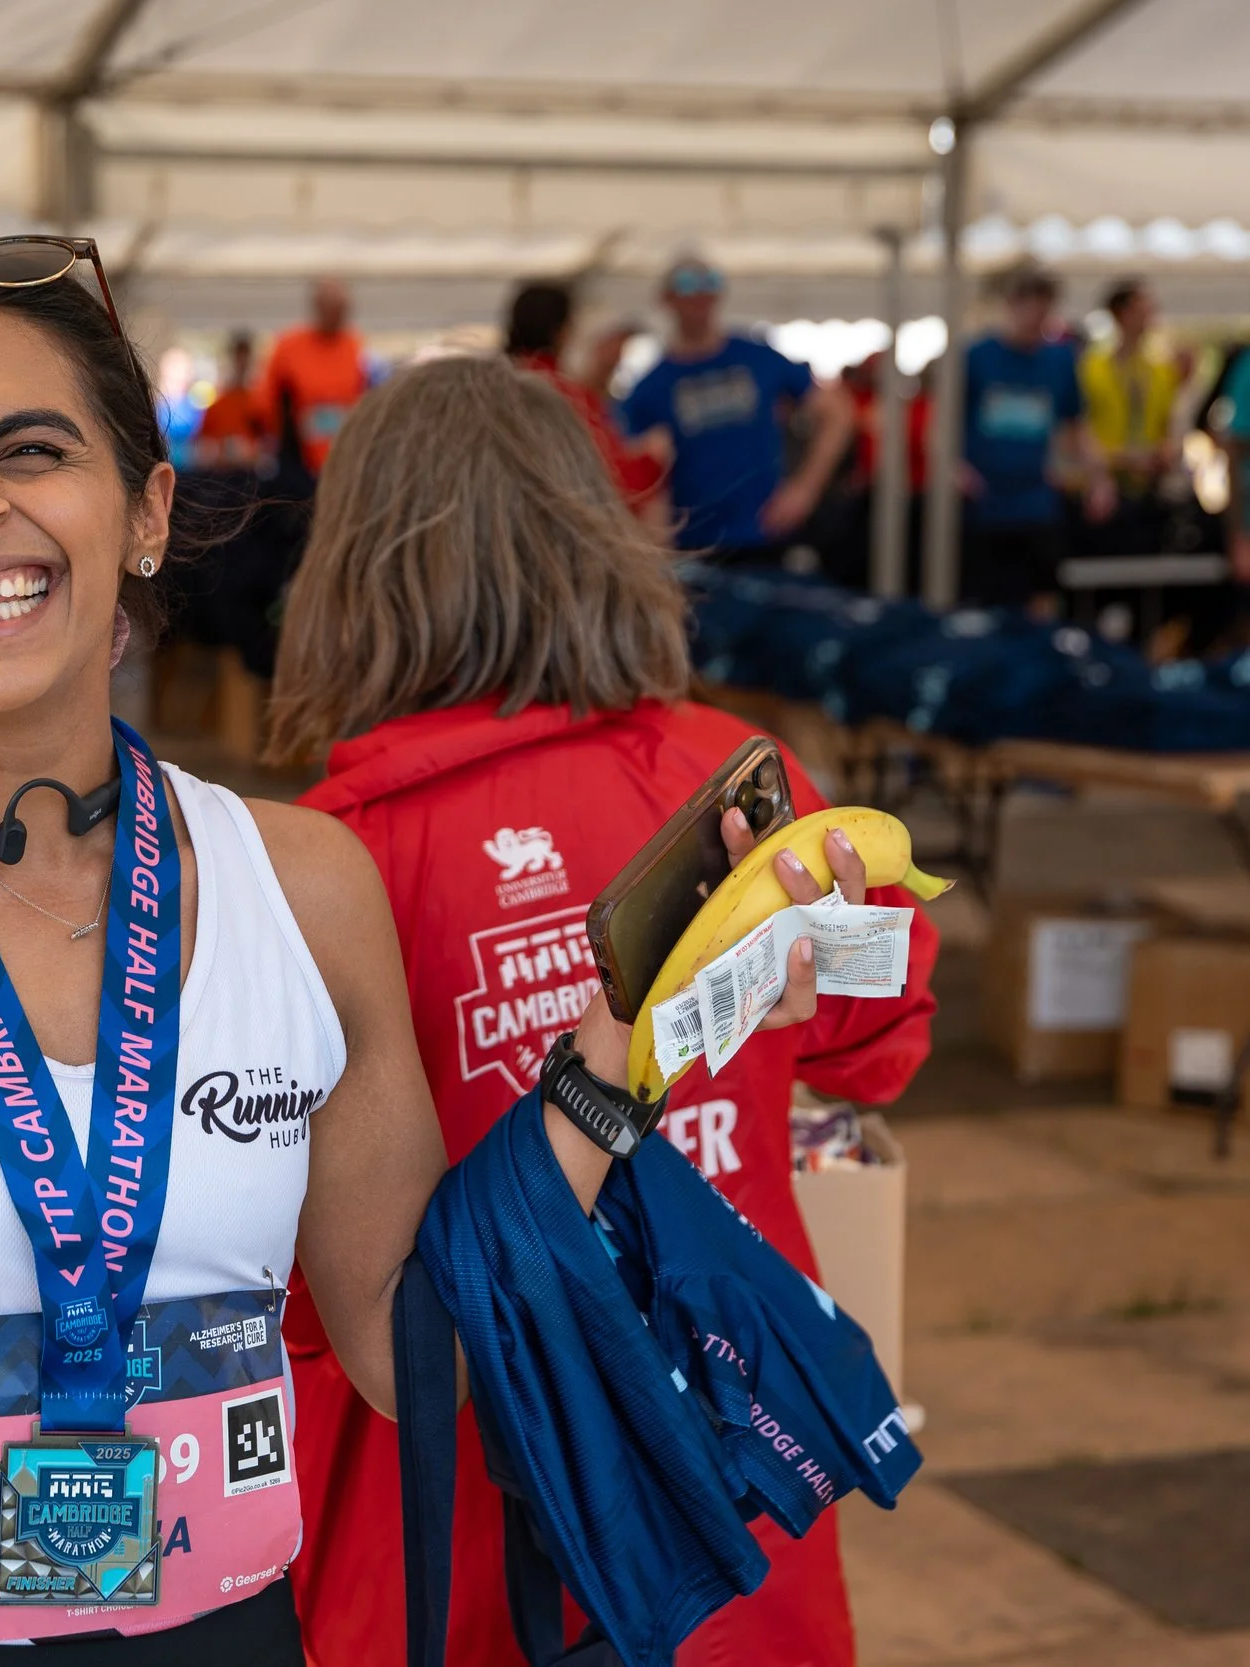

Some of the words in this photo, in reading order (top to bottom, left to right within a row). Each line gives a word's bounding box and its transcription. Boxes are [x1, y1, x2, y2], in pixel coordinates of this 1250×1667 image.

[123, 922, 158, 1024] HALF
[246, 1067, 283, 1085] THE
[270, 1128, 299, 1148] HUB
[656, 1099, 742, 1178] ER
[34, 1174, 82, 1248] TTP
[60, 1313, 103, 1332] CAMBRIDGE
[190, 1321, 242, 1341] ALZHEIMER'S
[245, 1321, 258, 1333] FOR
[258, 1319, 264, 1330] A
[200, 1332, 243, 1350] RESEARCH
[233, 1342, 244, 1352] UK
[246, 1331, 265, 1346] CURE
[63, 1348, 103, 1363] 2025
[95, 1447, 132, 1460] 2025
[28, 1502, 133, 1526] CAMBRIDGE
[67, 1525, 92, 1538] HALF
[47, 1530, 111, 1556] MARATHON
[6, 1576, 76, 1591] FINISHER
[235, 1565, 277, 1587] Gearset
[67, 1606, 99, 1617] T-SHIRT
